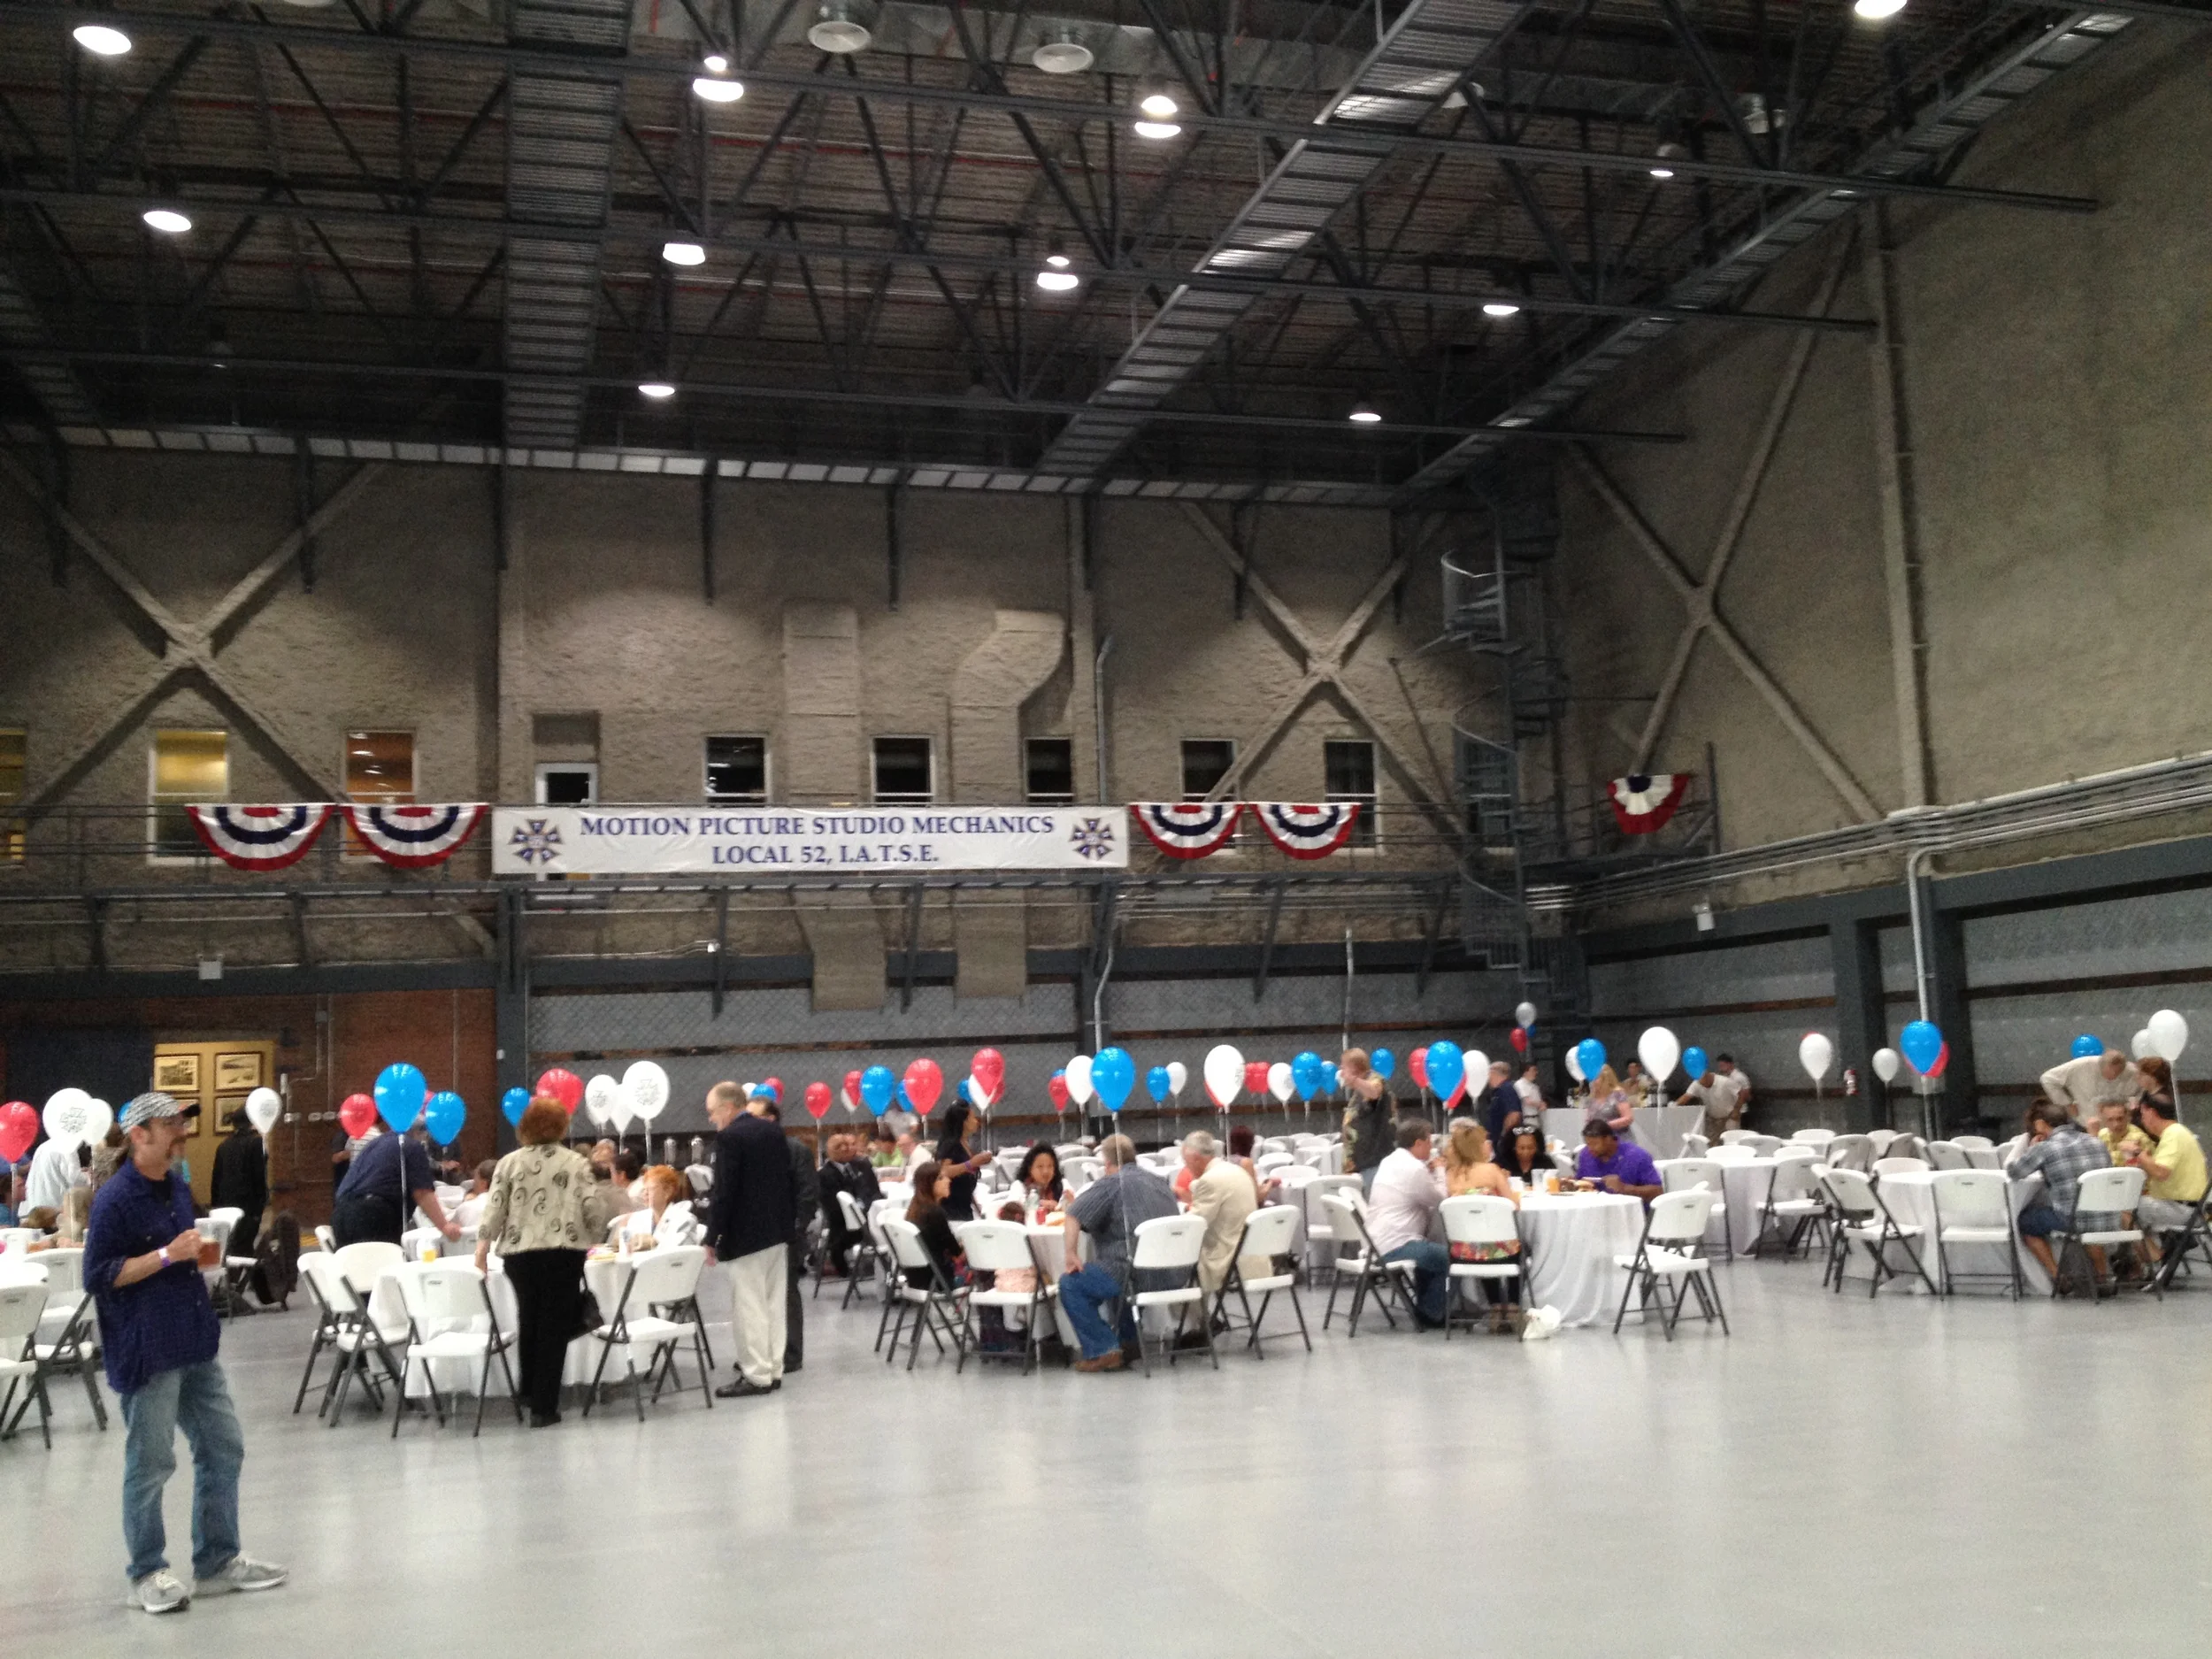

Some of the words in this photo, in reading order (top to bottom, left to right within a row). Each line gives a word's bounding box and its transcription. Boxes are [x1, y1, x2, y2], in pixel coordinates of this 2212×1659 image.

[580, 817, 691, 836] MOTION
[698, 817, 806, 836] PICTURE
[812, 816, 905, 835] STUDIO
[912, 815, 1055, 834] MECHANICS
[711, 845, 794, 864] LOCAL
[800, 844, 833, 864] 52,
[840, 843, 940, 864] I.A.T.S.E.
